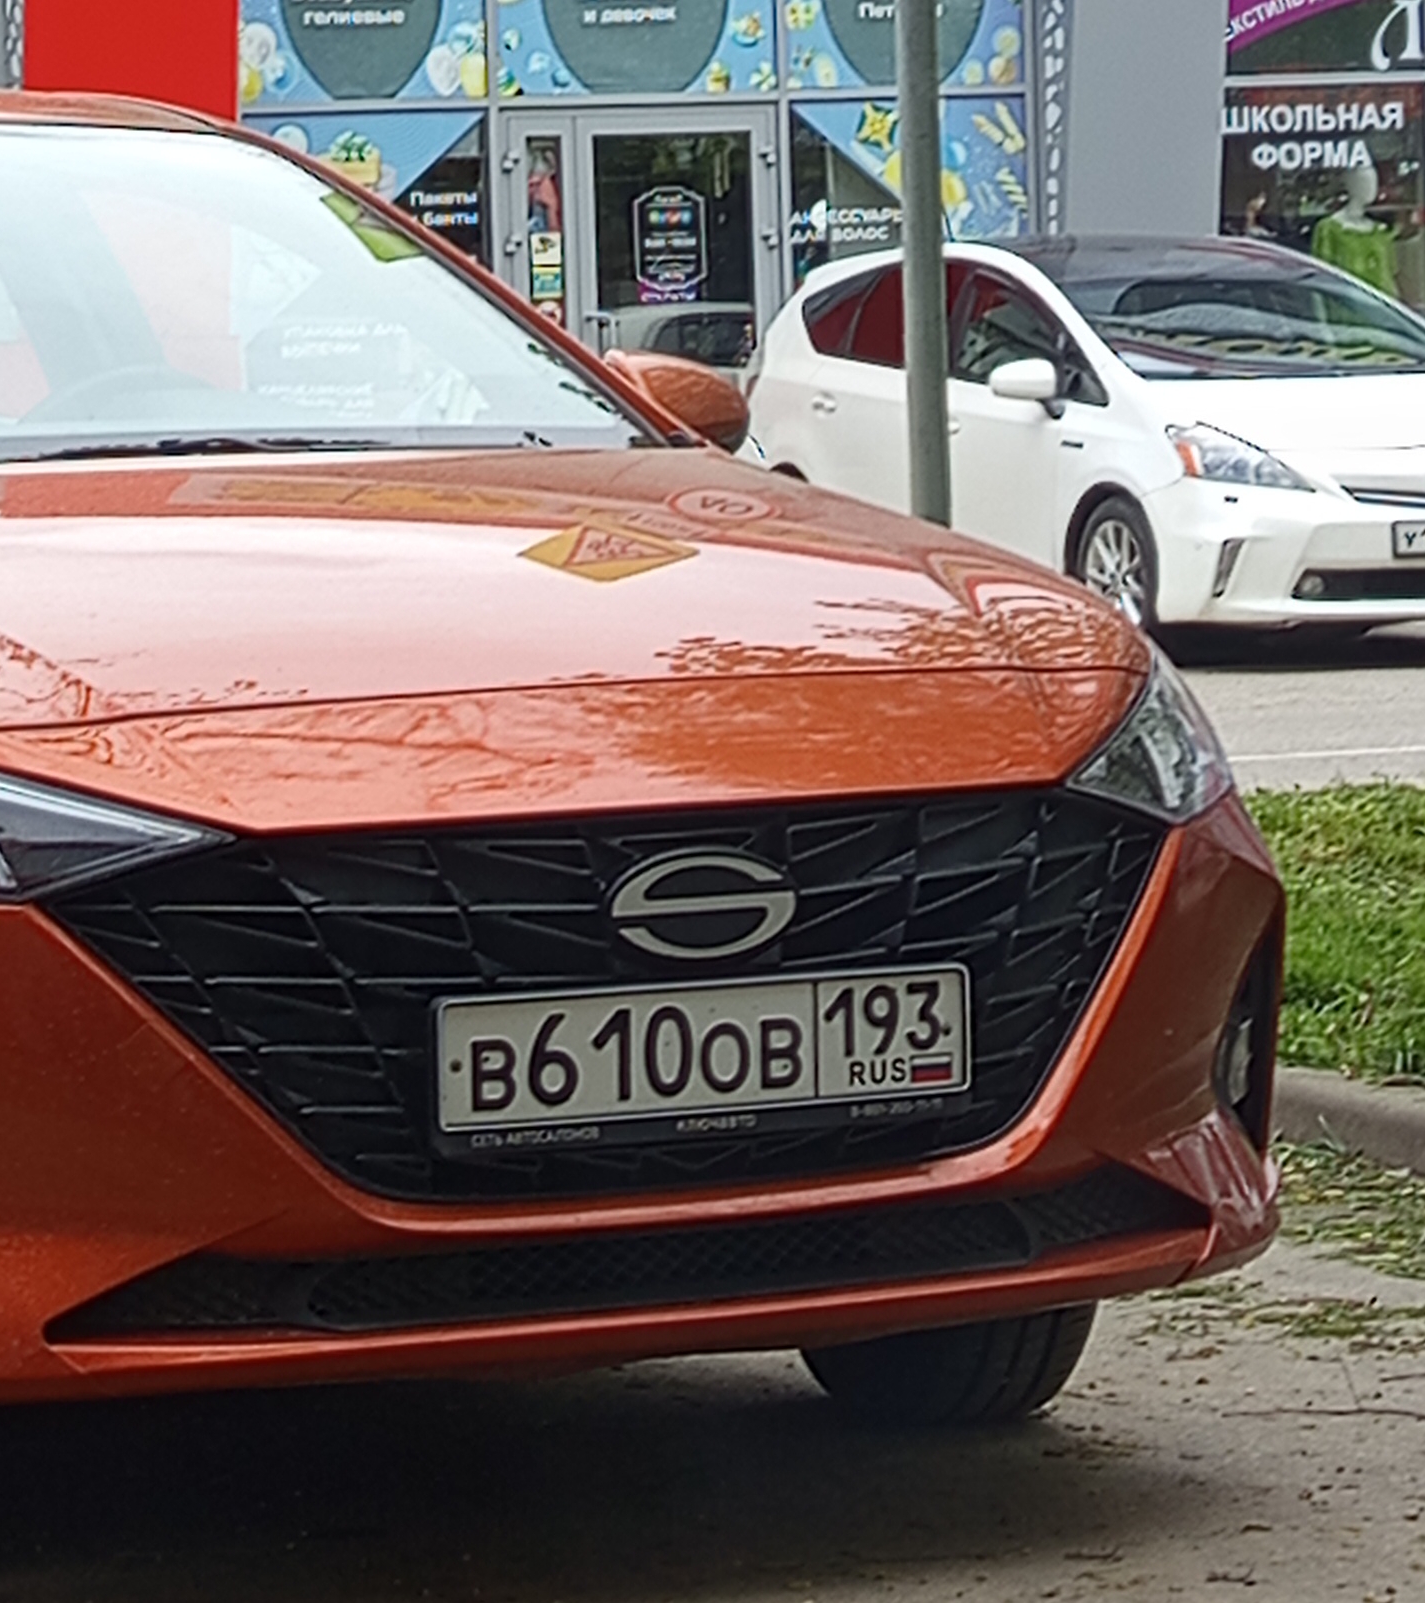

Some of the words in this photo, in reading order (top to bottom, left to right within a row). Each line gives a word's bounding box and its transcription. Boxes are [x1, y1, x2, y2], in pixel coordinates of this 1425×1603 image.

[1221, 102, 1405, 135] ШКОЛЬНАЯ
[1251, 140, 1373, 170] ФОРМА
[788, 206, 902, 226] АКЕССУАР
[832, 226, 890, 242] ВОЛОС
[469, 1004, 804, 1113] В610ОВ
[822, 980, 943, 1059] 193
[848, 1060, 908, 1087] RUS
